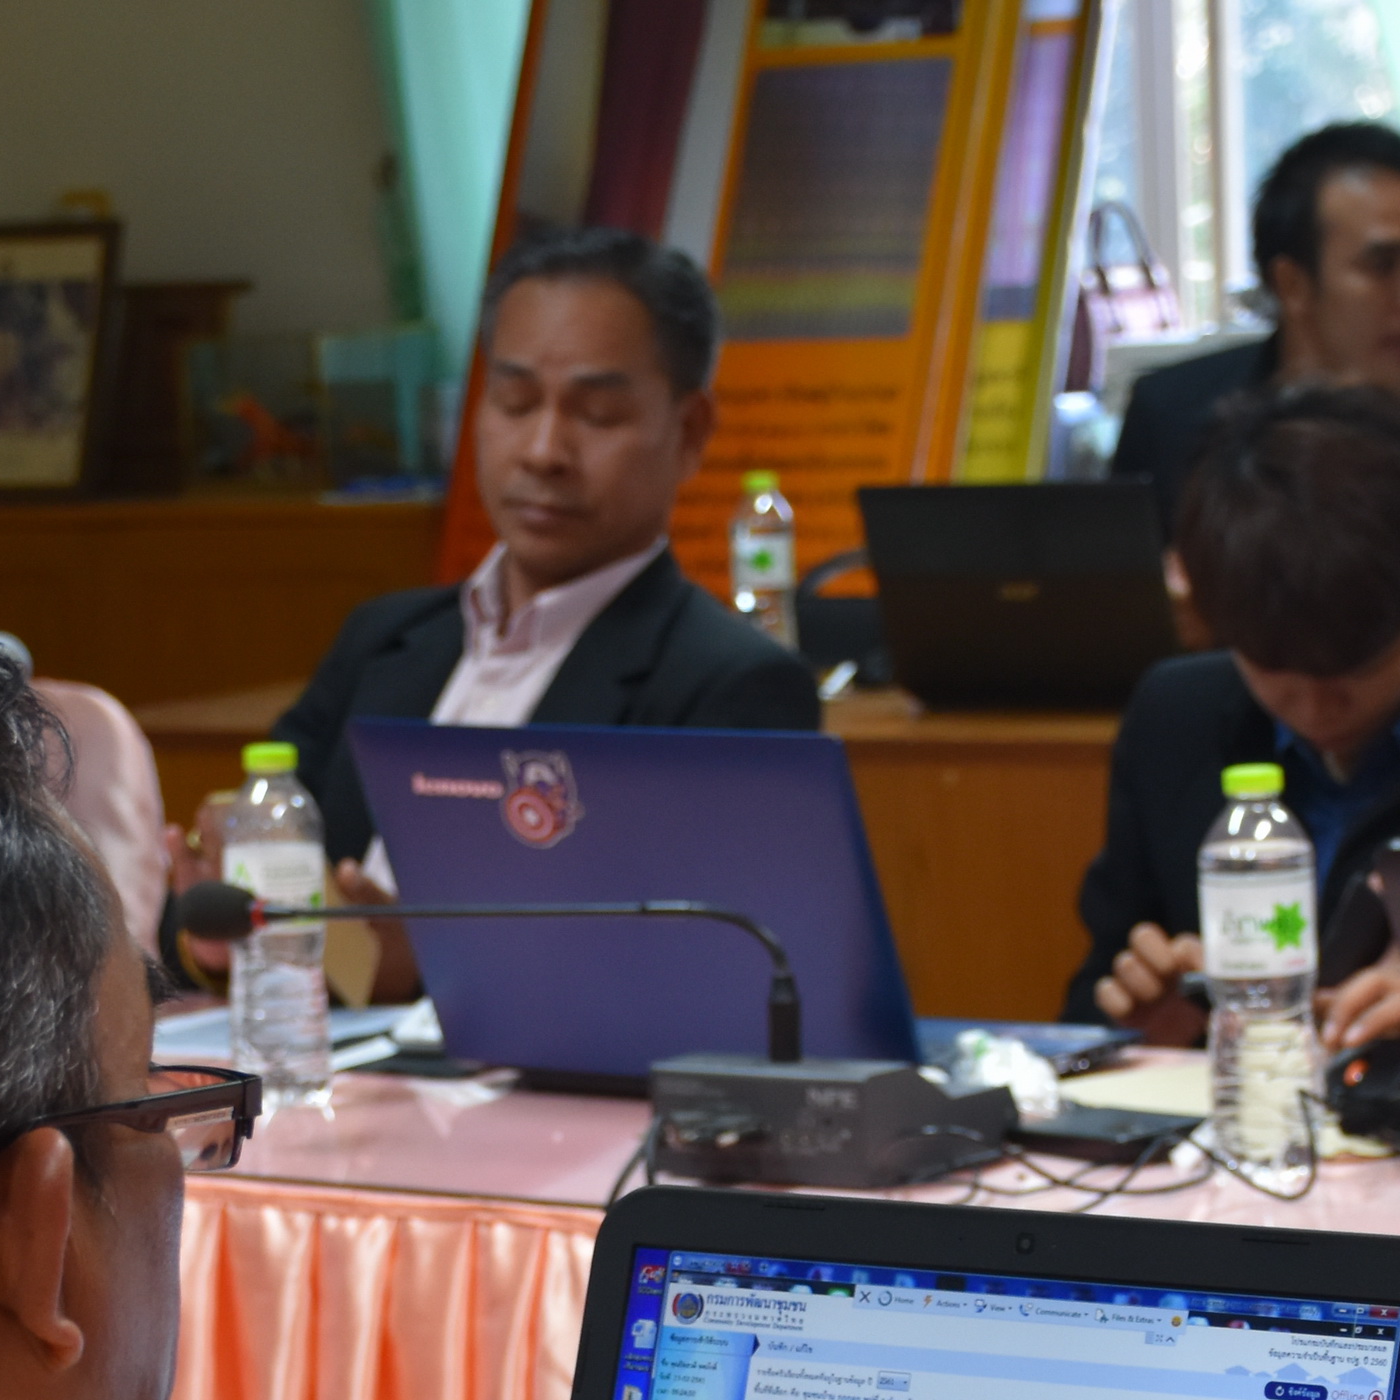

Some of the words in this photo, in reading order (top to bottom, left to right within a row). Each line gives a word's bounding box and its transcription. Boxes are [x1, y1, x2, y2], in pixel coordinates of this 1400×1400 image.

[894, 1296, 914, 1305] Home
[936, 1299, 961, 1309] Actions
[990, 1303, 1006, 1312] View
[1035, 1307, 1082, 1318] Communicate
